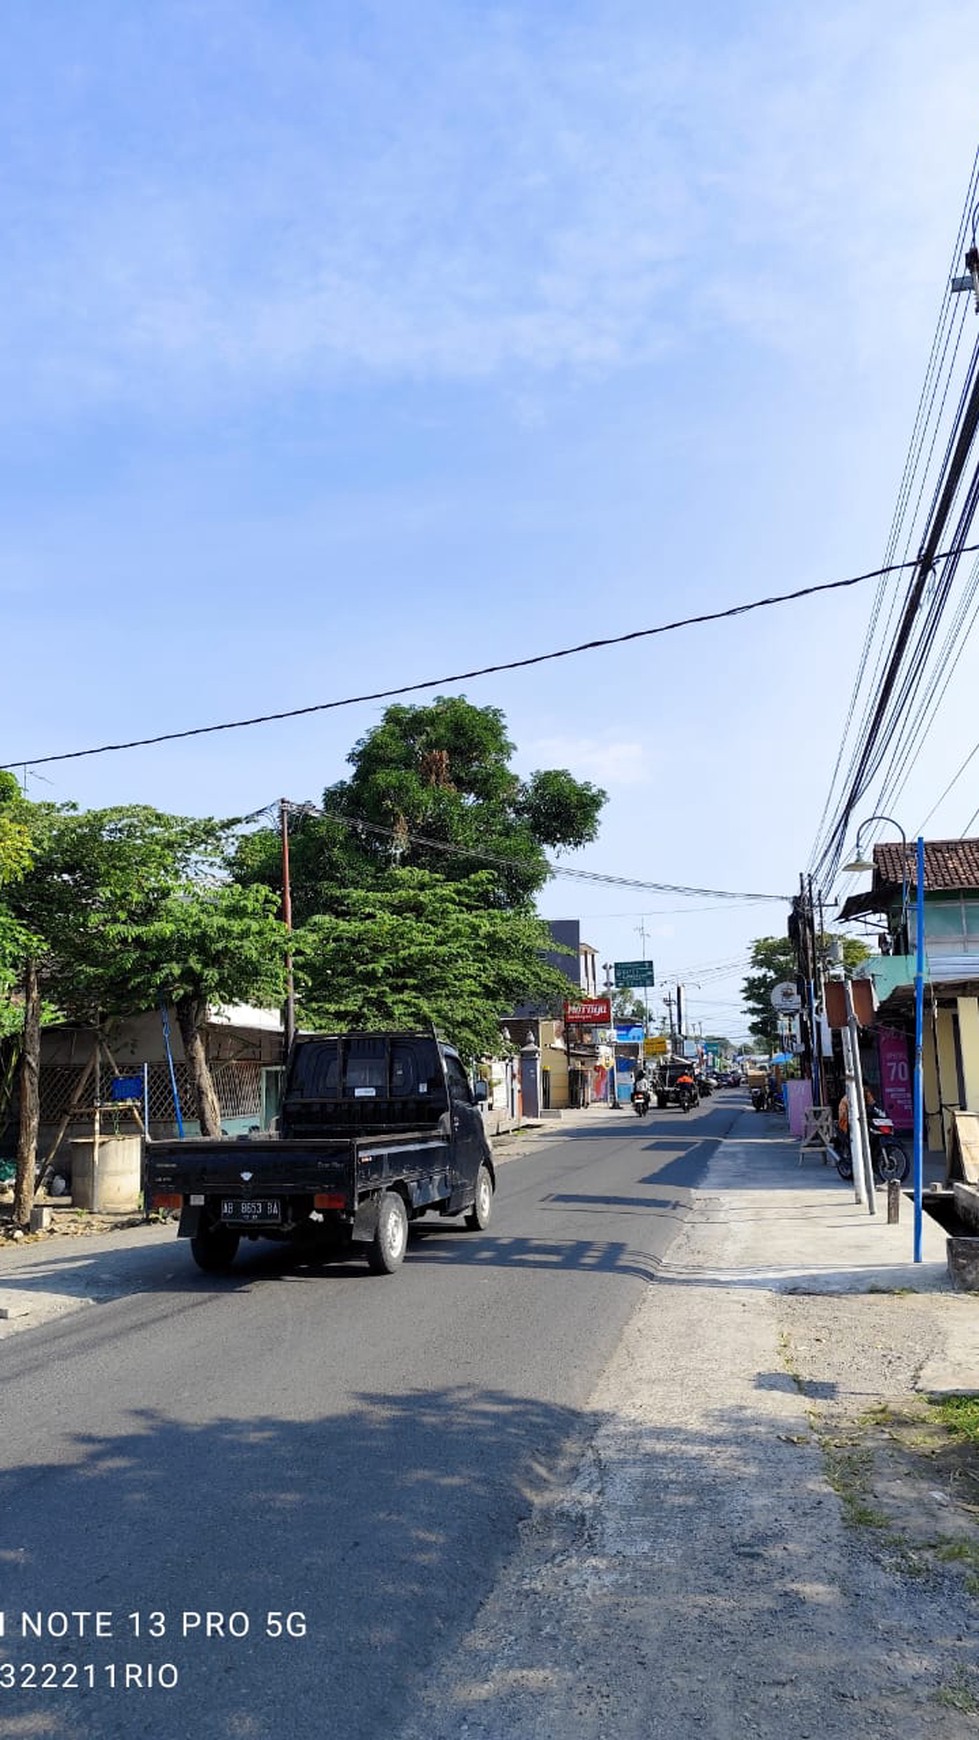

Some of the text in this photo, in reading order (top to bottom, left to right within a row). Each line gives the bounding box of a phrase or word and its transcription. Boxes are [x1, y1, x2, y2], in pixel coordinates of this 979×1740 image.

[887, 1061, 909, 1082] 70
[222, 1201, 278, 1214] AB 8653 BA
